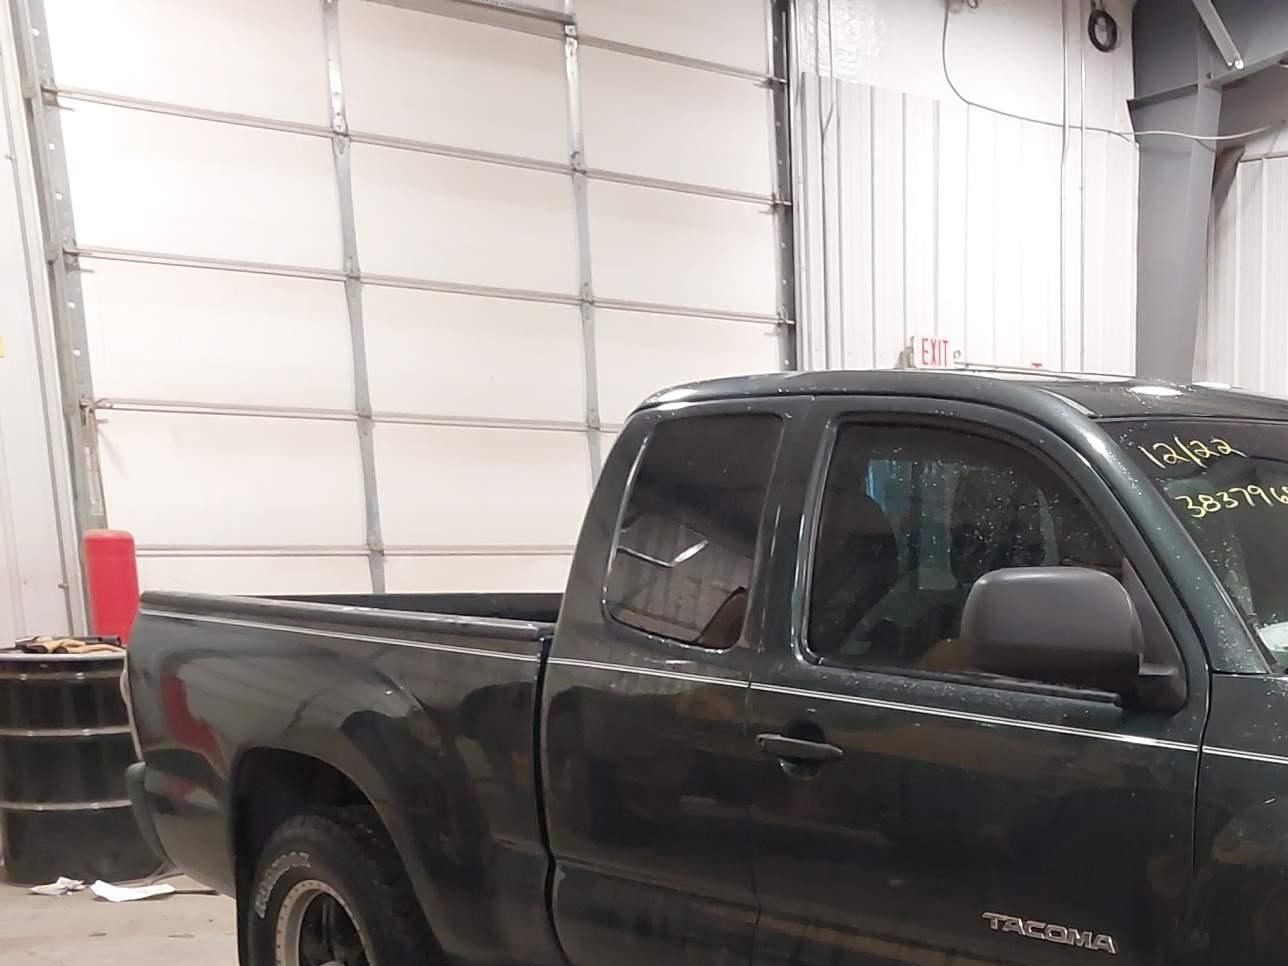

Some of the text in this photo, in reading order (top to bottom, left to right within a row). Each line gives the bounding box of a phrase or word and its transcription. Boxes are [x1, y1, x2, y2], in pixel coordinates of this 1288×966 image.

[921, 338, 948, 368] EXIT
[1137, 433, 1248, 469] 12/22
[982, 911, 1117, 954] TACOMA
